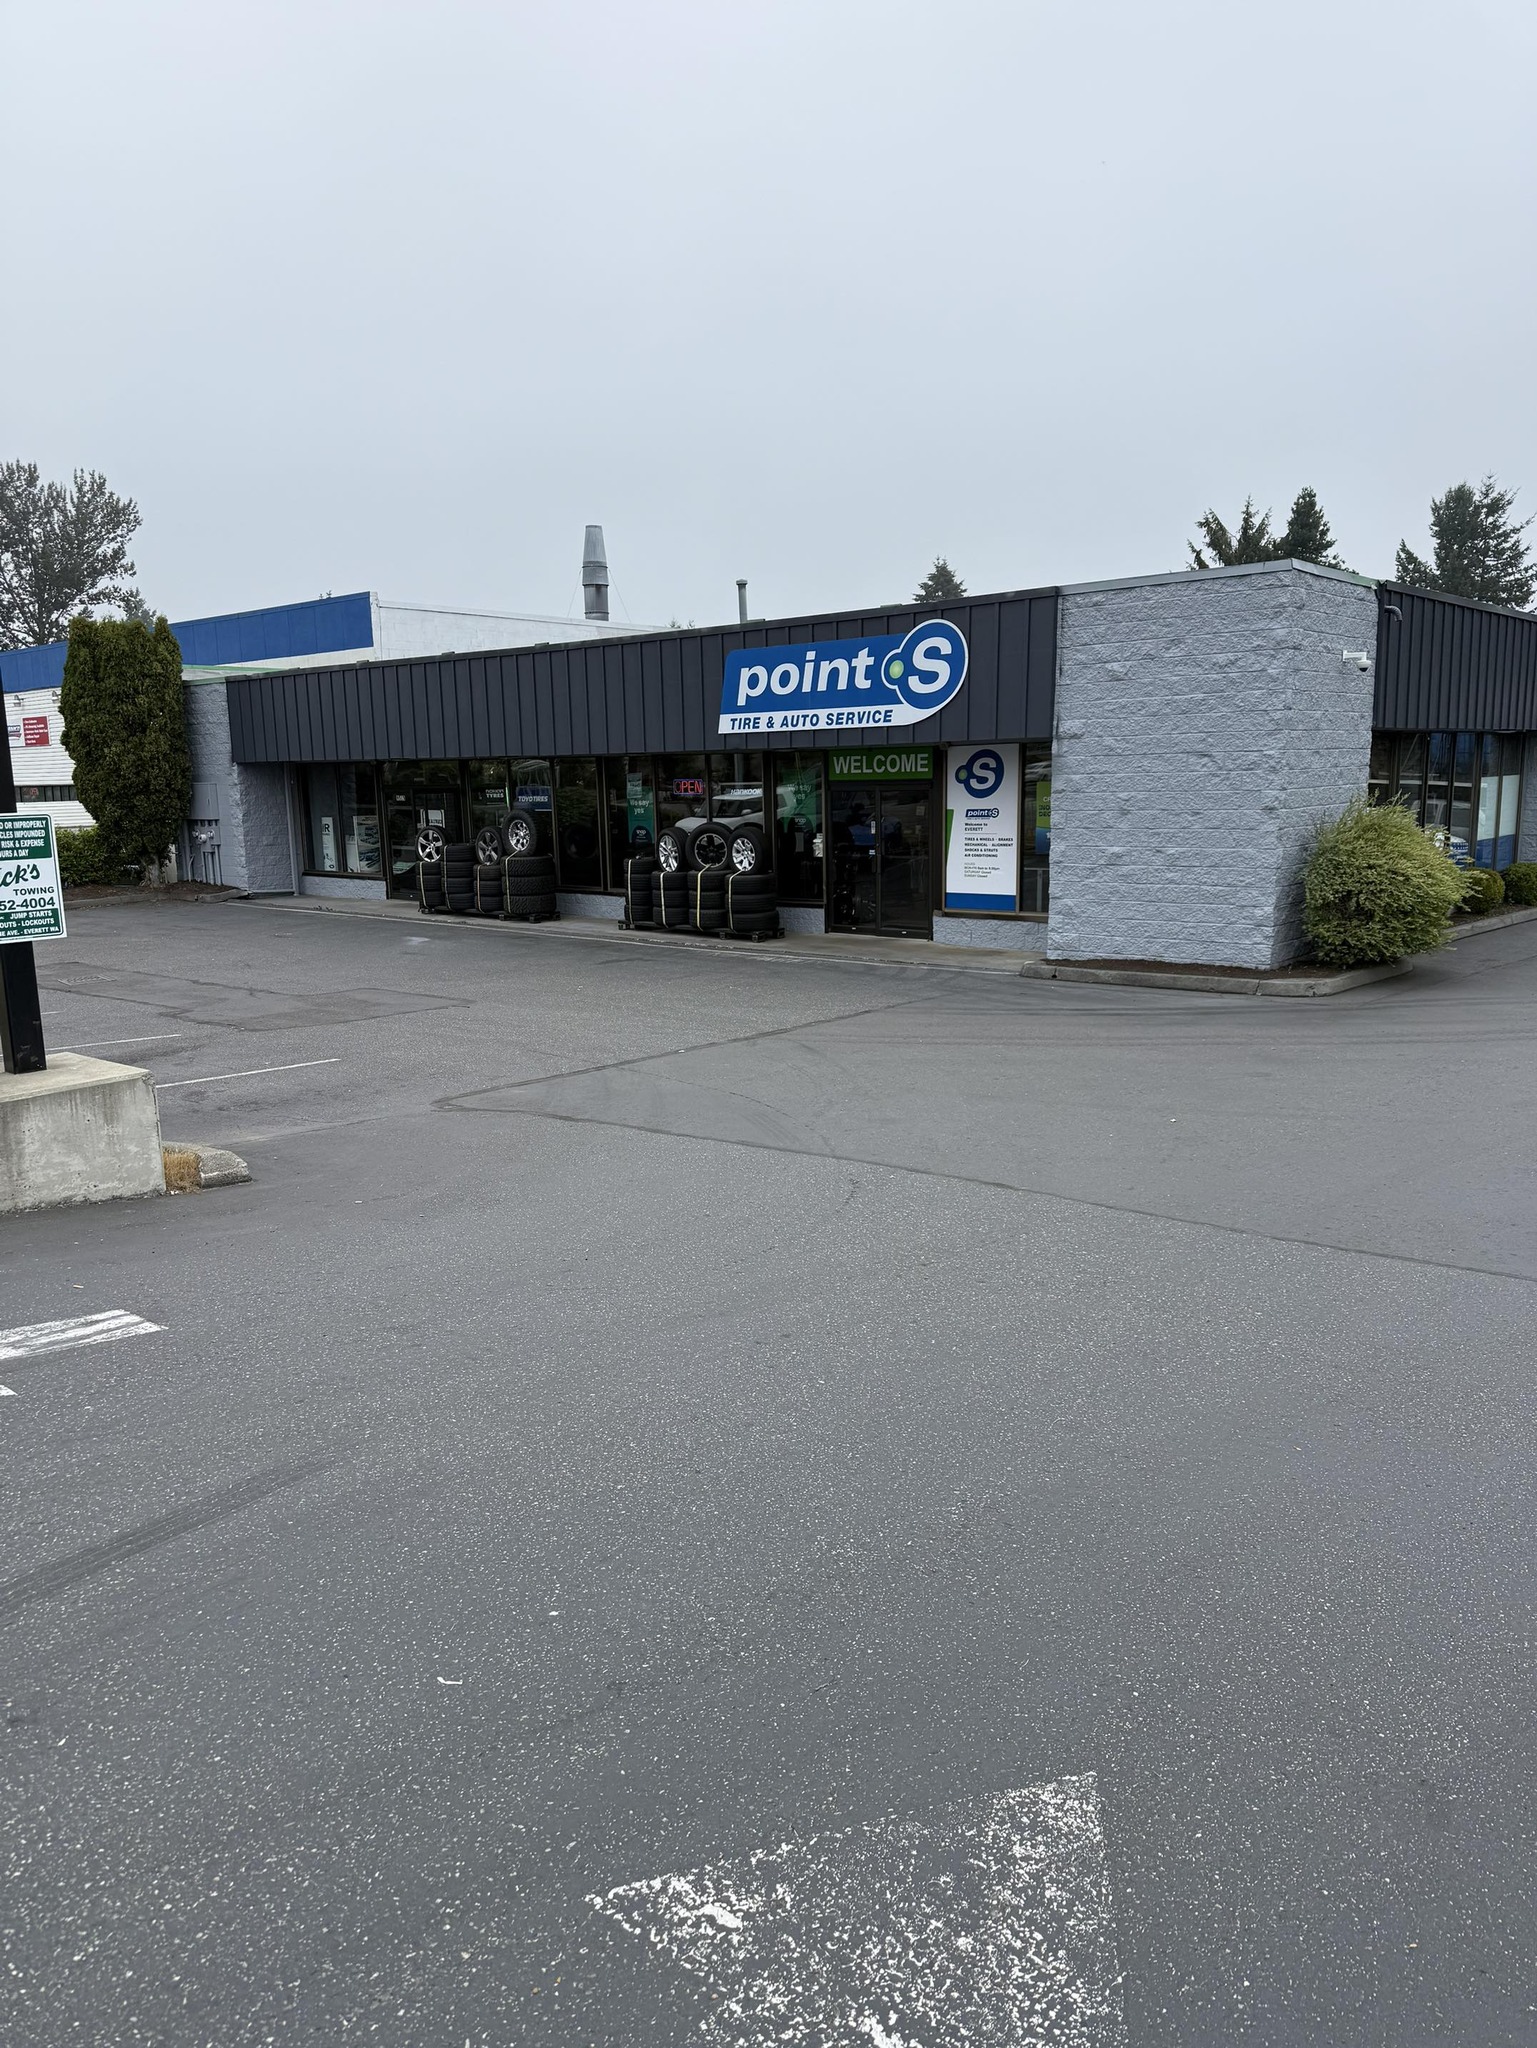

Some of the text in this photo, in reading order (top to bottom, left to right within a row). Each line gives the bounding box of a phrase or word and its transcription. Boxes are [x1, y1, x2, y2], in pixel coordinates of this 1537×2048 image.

[737, 647, 875, 706] point
[730, 709, 894, 730] TIRE & AUTO SERVICE
[833, 753, 929, 774] WELCOME
[674, 780, 703, 793] OPEN
[967, 809, 988, 817] point
[4, 821, 13, 829] OR
[13, 820, 47, 829] IMPROPERLY
[14, 829, 46, 839] IMPOUNDED
[1, 840, 15, 848] RISK
[20, 838, 45, 847] EXPENSE
[18, 848, 29, 857] DAY
[13, 886, 55, 896] TOWING
[10, 911, 28, 920] JUMP
[28, 909, 52, 919] STARTS
[21, 917, 55, 927] LOCKOUTS
[23, 926, 49, 935] EVERETT
[49, 925, 60, 933] WA
